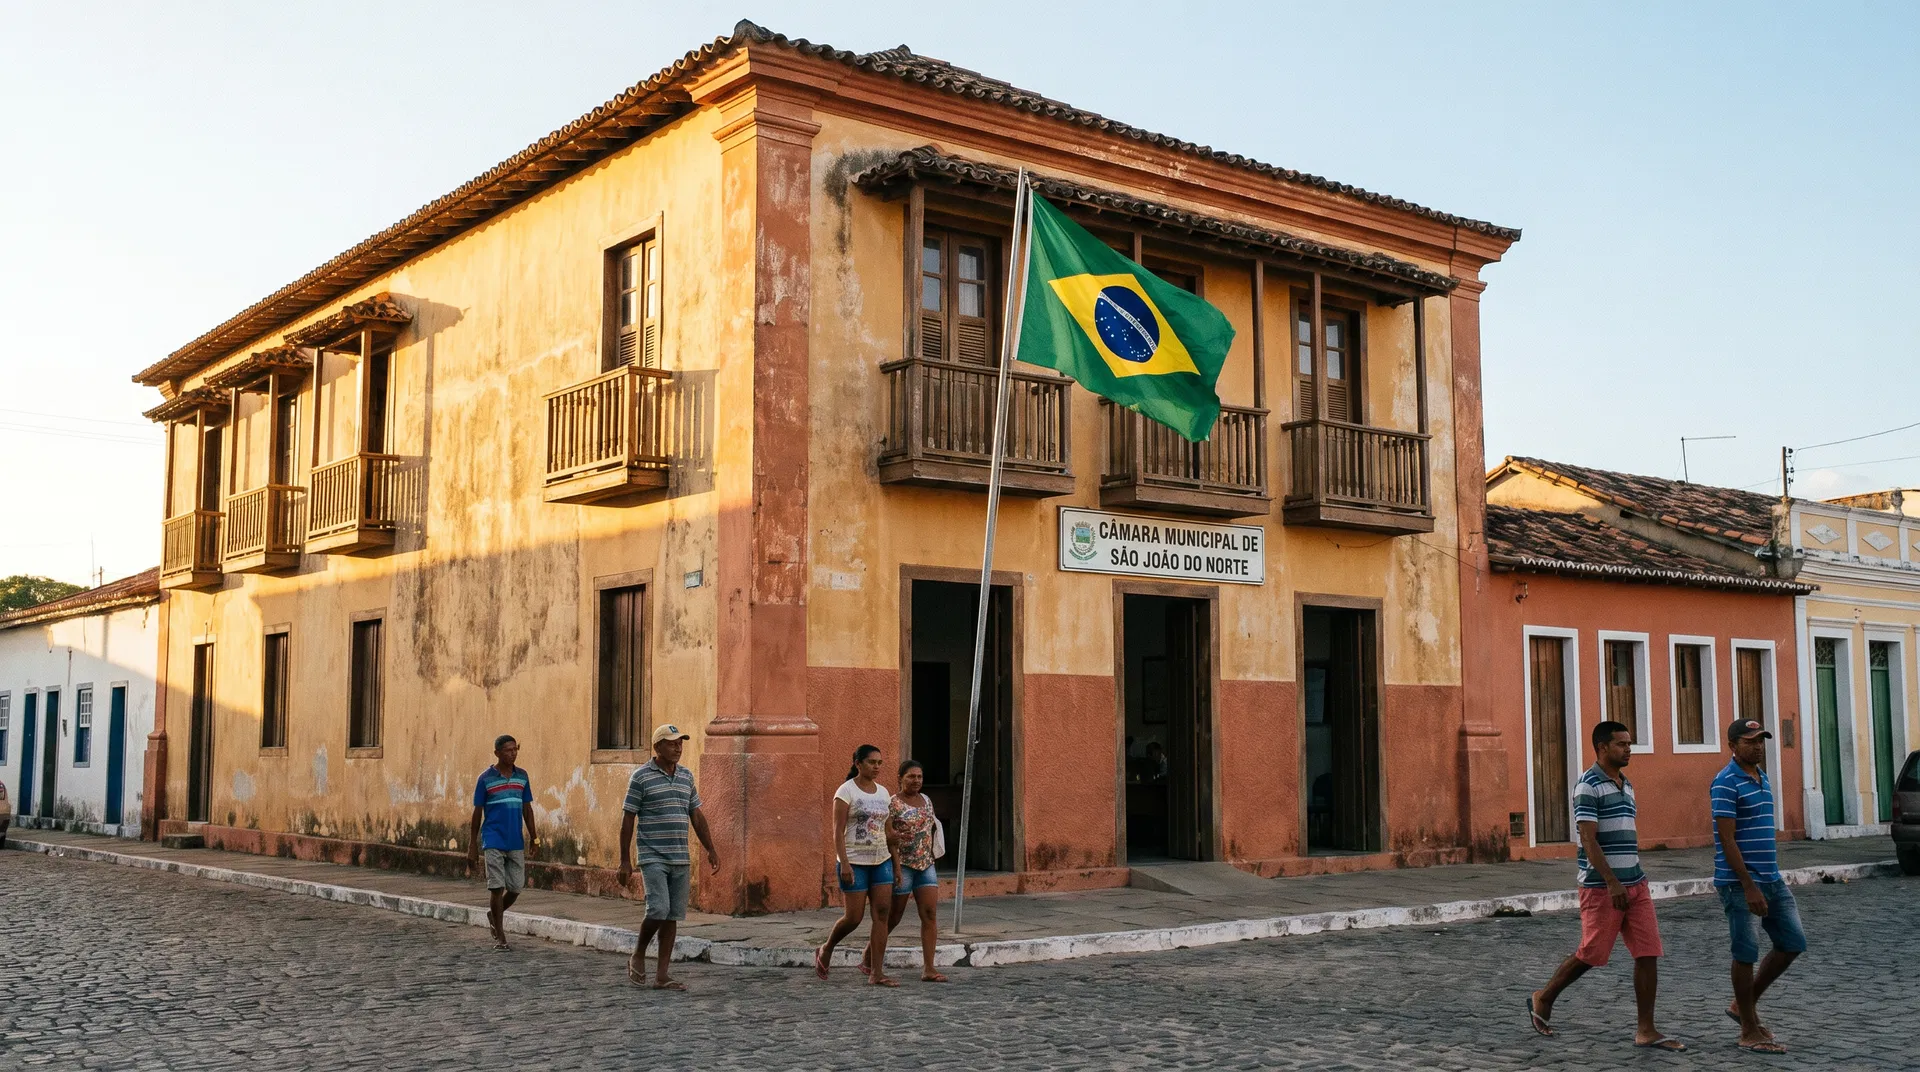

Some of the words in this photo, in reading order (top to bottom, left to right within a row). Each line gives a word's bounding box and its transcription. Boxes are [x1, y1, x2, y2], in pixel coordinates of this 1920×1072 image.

[1099, 518, 1160, 544] CÂMARA
[1165, 527, 1238, 551] MUNICIPAL
[1242, 535, 1258, 552] DE
[1111, 545, 1138, 567] SÃO
[1143, 549, 1179, 570] JOÃO
[1184, 554, 1202, 571] DO
[1206, 556, 1248, 576] NORTE
